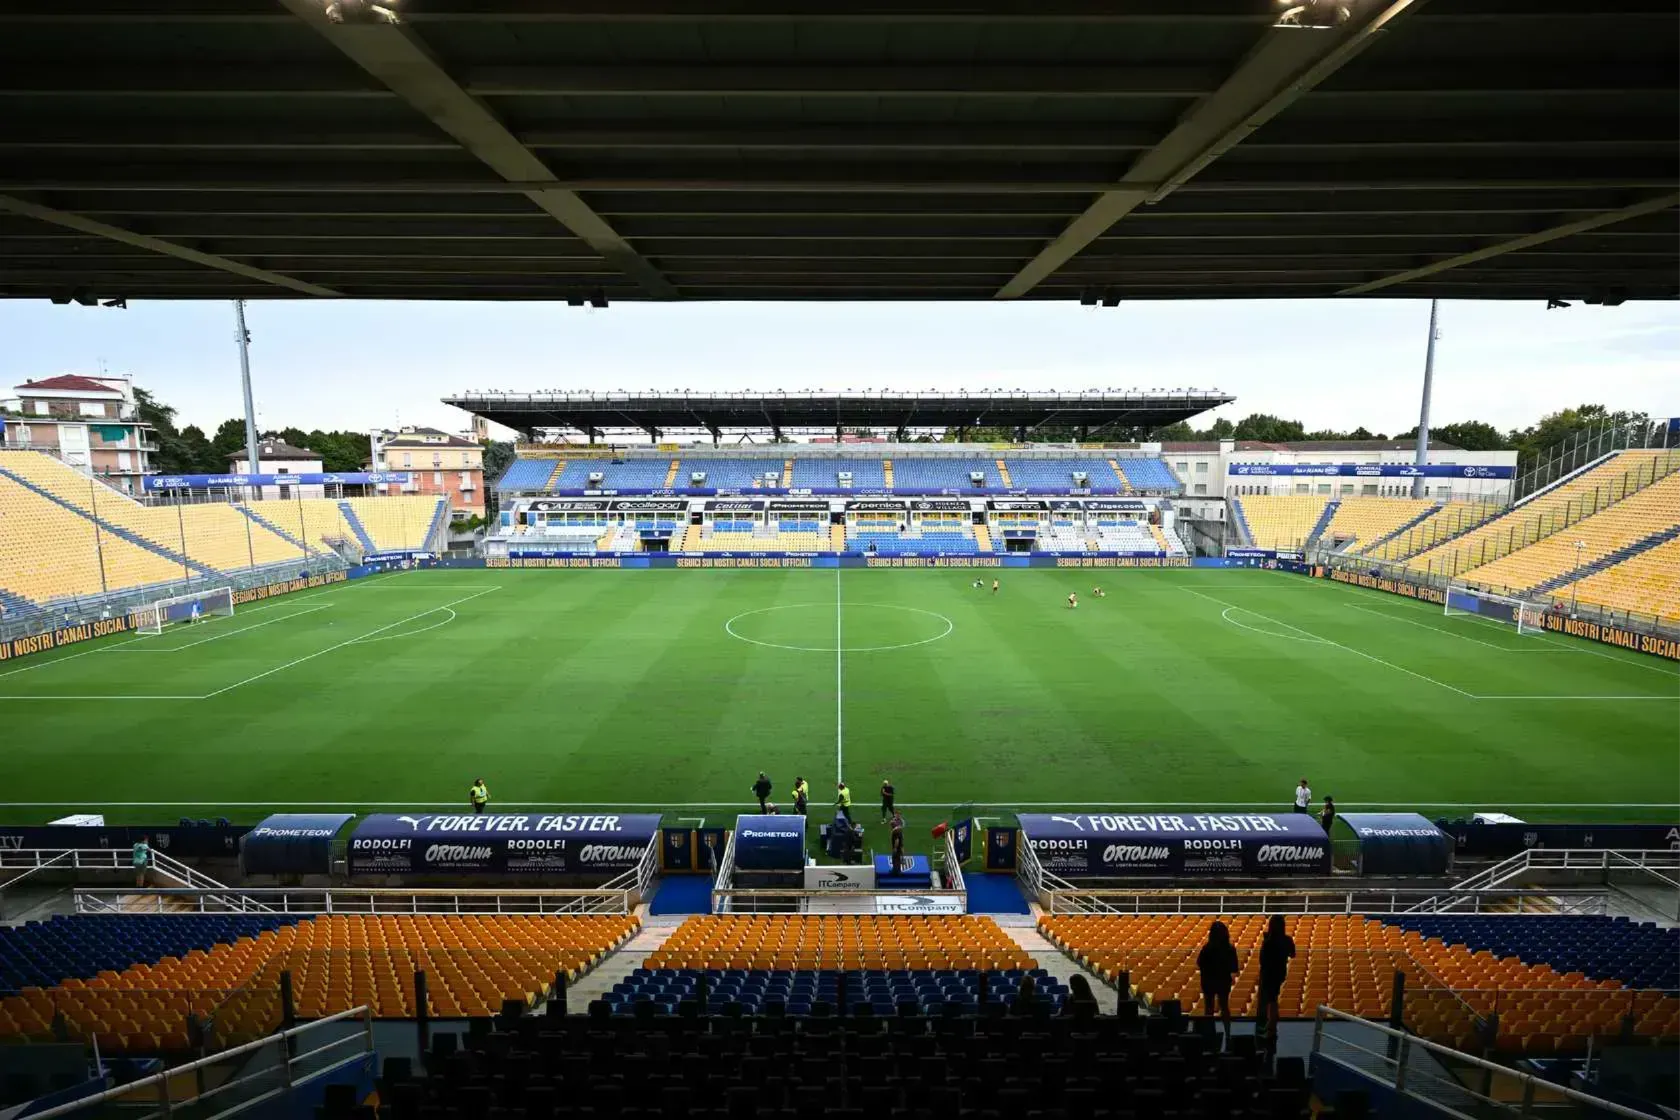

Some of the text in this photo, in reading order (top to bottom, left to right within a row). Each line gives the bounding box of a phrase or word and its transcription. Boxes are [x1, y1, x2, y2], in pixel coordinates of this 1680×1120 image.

[486, 558, 620, 567] SEGUICI SUI NOSTRI CANALI SOCIAL UFFICIALI
[677, 558, 811, 567] SEGUICI SUI NOSTRI CANALI SOCIAL UFFICIALI
[867, 558, 891, 567] SEGUICI
[892, 558, 902, 567] SUI
[904, 558, 925, 567] NOSTRI
[950, 558, 971, 567] SOCIAL
[973, 558, 1000, 567] UFFICIALI
[1057, 558, 1192, 567] SEGUICI SUI NOSTRI CANALI SOCIAL UFFICIALI
[15, 632, 53, 656] NOSTRI
[56, 624, 92, 645] CANALI
[94, 616, 126, 636] SOCIAL
[129, 608, 168, 628] UFFICILI
[1513, 608, 1545, 627] SGUICI
[1547, 615, 1562, 631] SUI
[1565, 619, 1599, 639] NOSTRI
[1602, 627, 1638, 649] CANALI
[427, 816, 622, 831] FOREVER. FASTER.
[1088, 816, 1288, 831] FOREVER. FASTER.
[255, 828, 333, 836] PROMETEON
[1360, 828, 1439, 836] PROMETEON
[353, 840, 411, 849] RODOLFI
[507, 840, 565, 849] RODOLFI
[1031, 840, 1088, 849] RODOLFI
[1184, 840, 1242, 849] RODOLFI
[425, 845, 492, 862] ORTOLINA
[580, 845, 646, 862] ORTOLINA
[1103, 845, 1170, 862] ORTOLINA
[1257, 845, 1324, 862] ORTOLINA
[818, 880, 860, 888] ITCompany
